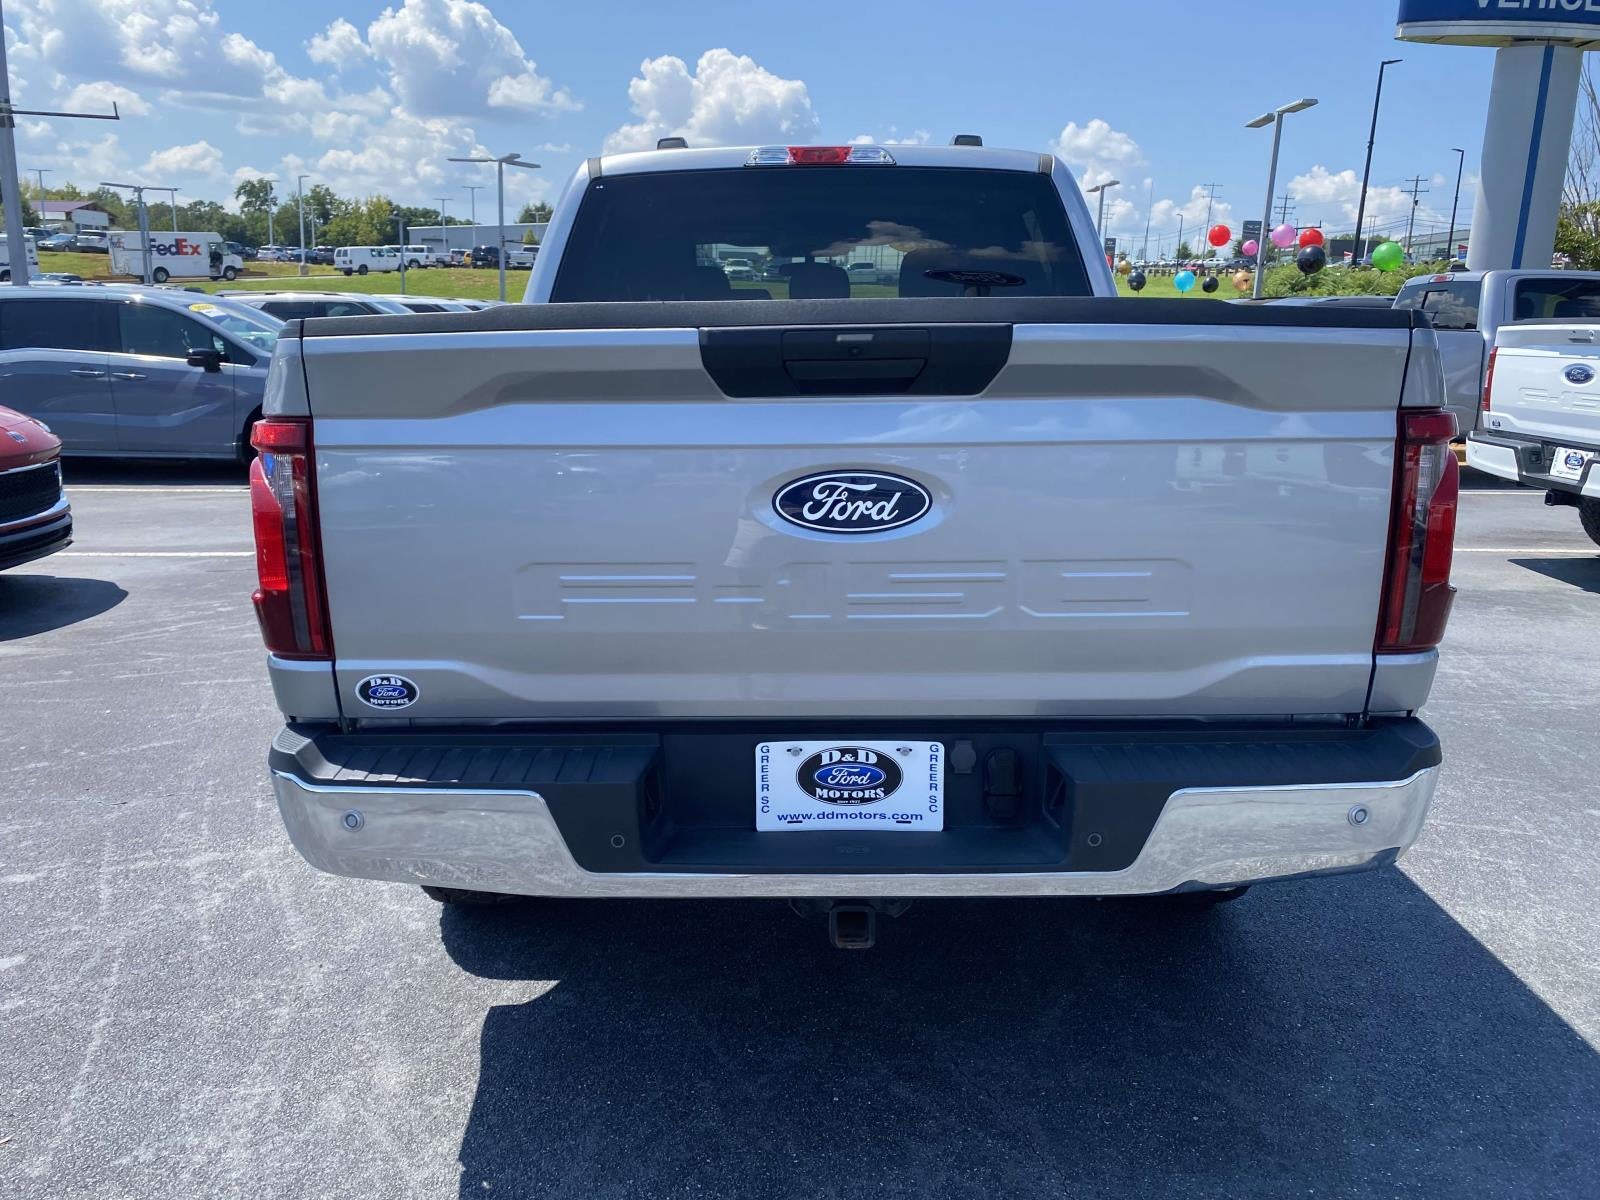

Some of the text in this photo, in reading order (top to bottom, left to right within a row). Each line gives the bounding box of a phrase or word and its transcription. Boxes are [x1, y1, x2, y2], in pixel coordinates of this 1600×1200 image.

[802, 481, 902, 521] Ford
[369, 677, 402, 686] D&D
[375, 687, 400, 697] Ford
[820, 749, 878, 766] D&D
[761, 744, 770, 813] GREER SC
[827, 767, 870, 785] Ford
[928, 744, 939, 813] GREER SC
[815, 787, 885, 799] MOTORS
[777, 811, 923, 822] www.ddmotors.com
